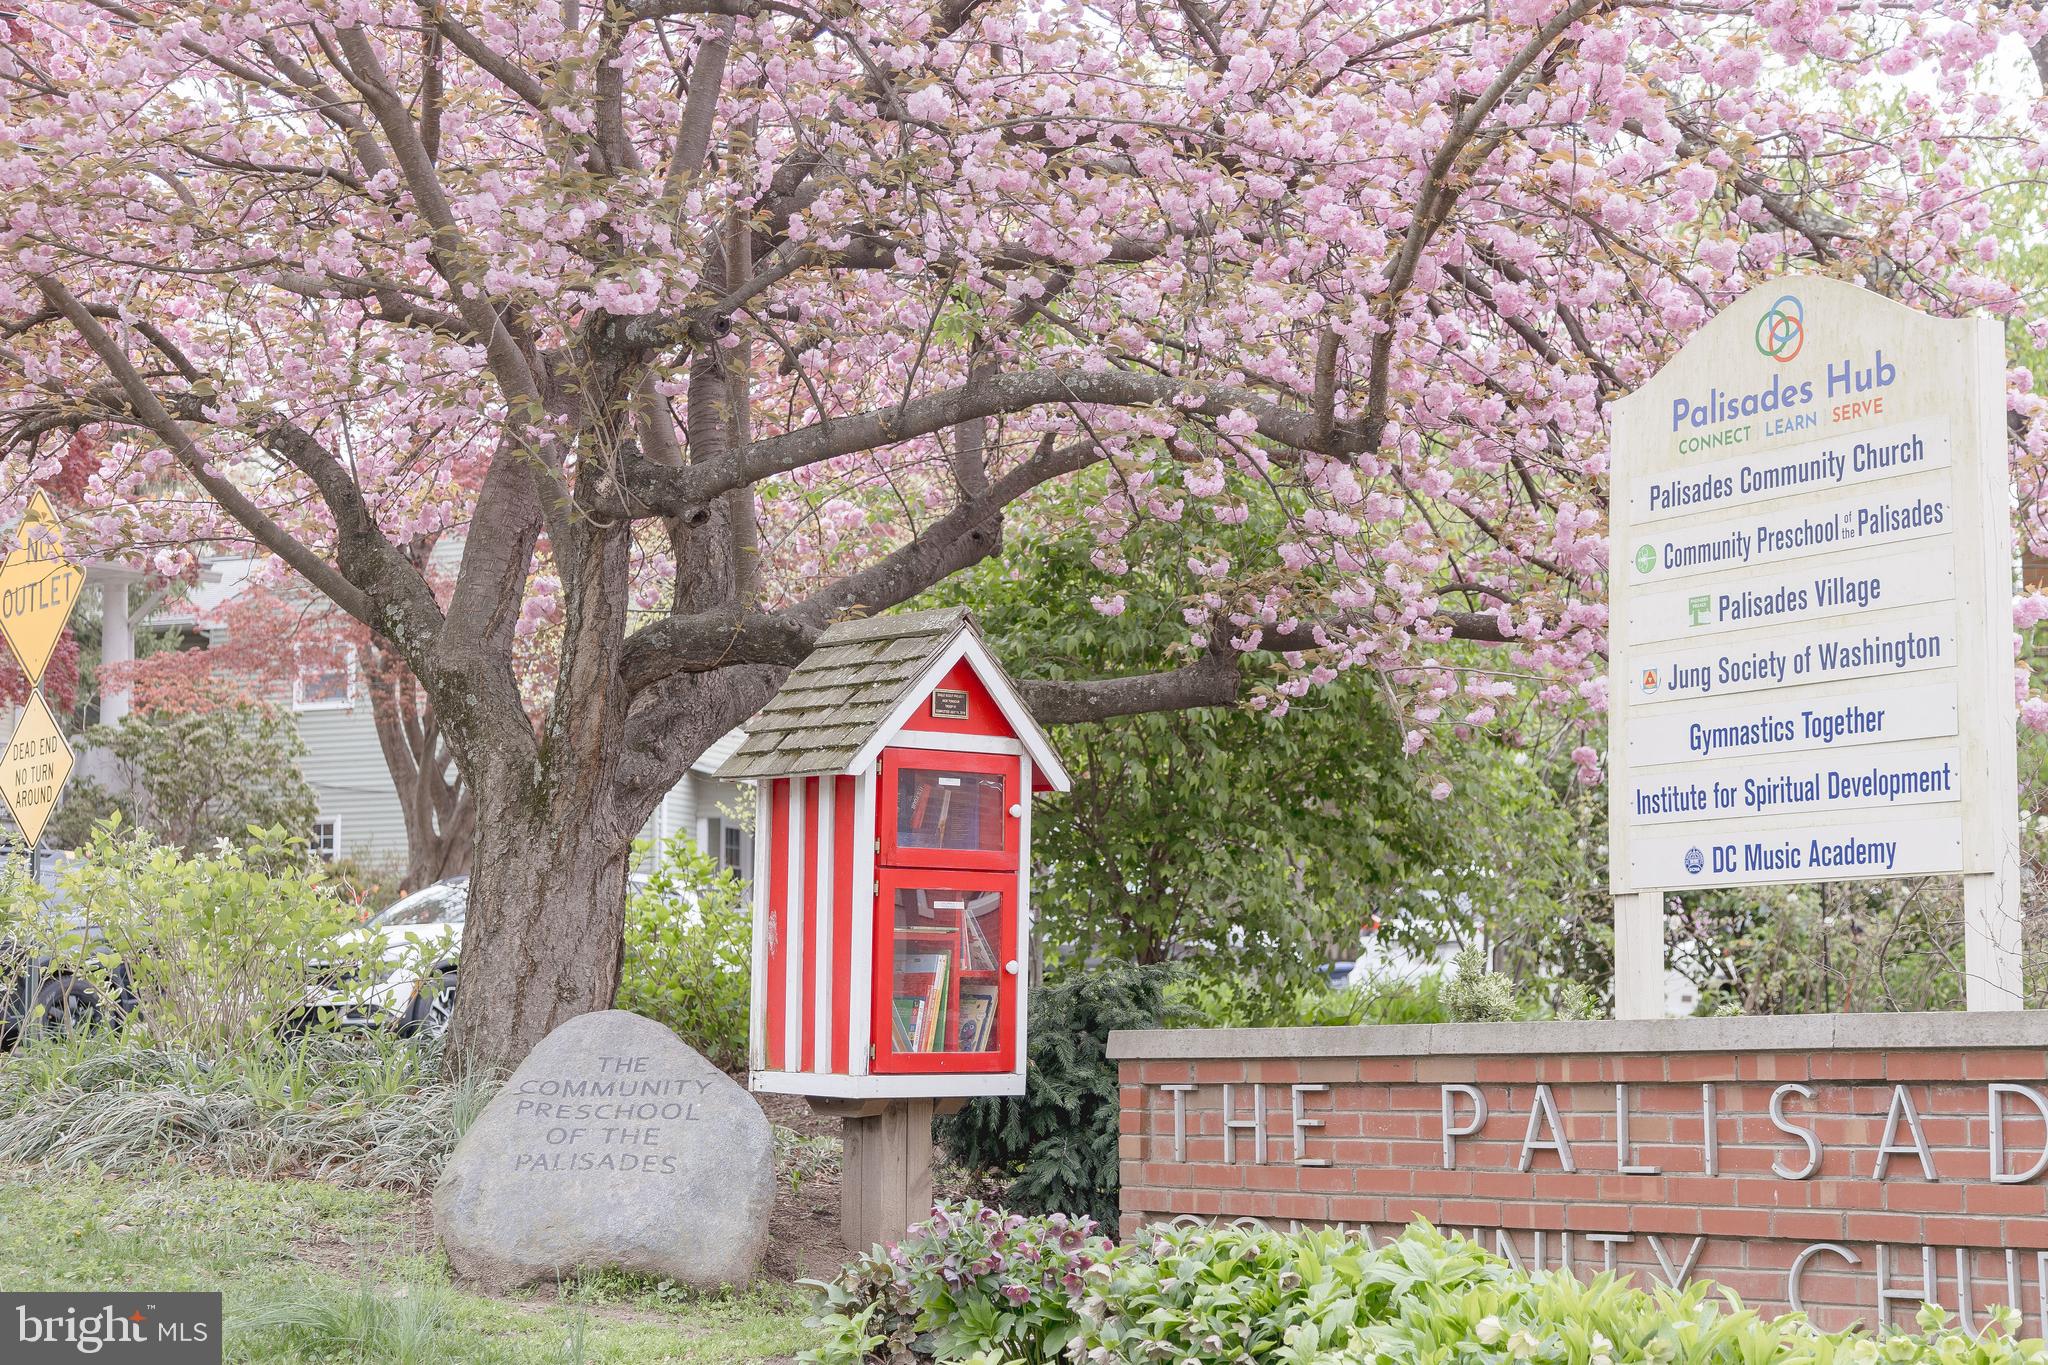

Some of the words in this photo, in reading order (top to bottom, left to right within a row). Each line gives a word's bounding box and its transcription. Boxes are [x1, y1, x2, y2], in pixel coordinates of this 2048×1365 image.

[1672, 374, 1813, 431] Palisades
[1827, 350, 1896, 398] Hub
[1678, 425, 1752, 454] CONNECT
[1765, 411, 1817, 437] LEARN
[1832, 397, 1883, 423] SERVE
[1649, 475, 1733, 511] Palisades
[1740, 452, 1845, 494] Community
[1853, 434, 1924, 471] Church
[1757, 515, 1839, 552] Preschool
[1841, 526, 1855, 540] the
[1843, 511, 1852, 523] of
[1858, 499, 1943, 536] Palisades
[1664, 535, 1751, 569] Community
[3, 572, 73, 618] OUTLET
[1719, 586, 1808, 621] Palisades
[1815, 576, 1881, 607] Village
[1668, 664, 1711, 692] Jung
[1718, 651, 1787, 684] Society
[1794, 646, 1811, 674] of
[1818, 632, 1941, 670] Washington
[13, 741, 36, 761] DEAD
[40, 735, 58, 755] END
[1690, 716, 1795, 755] Gymnastics
[1801, 707, 1885, 743] Together
[15, 768, 27, 786] NO
[31, 762, 54, 783] TURN
[1636, 784, 1707, 815] Institute
[1714, 782, 1737, 808] for
[1744, 774, 1820, 812] Spiritual
[1828, 763, 1951, 803] Development
[16, 785, 53, 808] AROUND
[1712, 845, 1736, 873] DC
[1745, 842, 1801, 871] Music
[1809, 837, 1896, 869] Academy
[599, 1057, 650, 1073] THE
[519, 1079, 713, 1098] COMMUNITY
[516, 1100, 700, 1121] PRESCHOOL
[546, 1127, 587, 1145] OF
[602, 1127, 661, 1146] THE
[1161, 1084, 1332, 1168] THE
[1441, 1083, 2048, 1184] PALISAD
[515, 1152, 678, 1175] PALISADES
[1788, 1243, 2048, 1345] CHU
